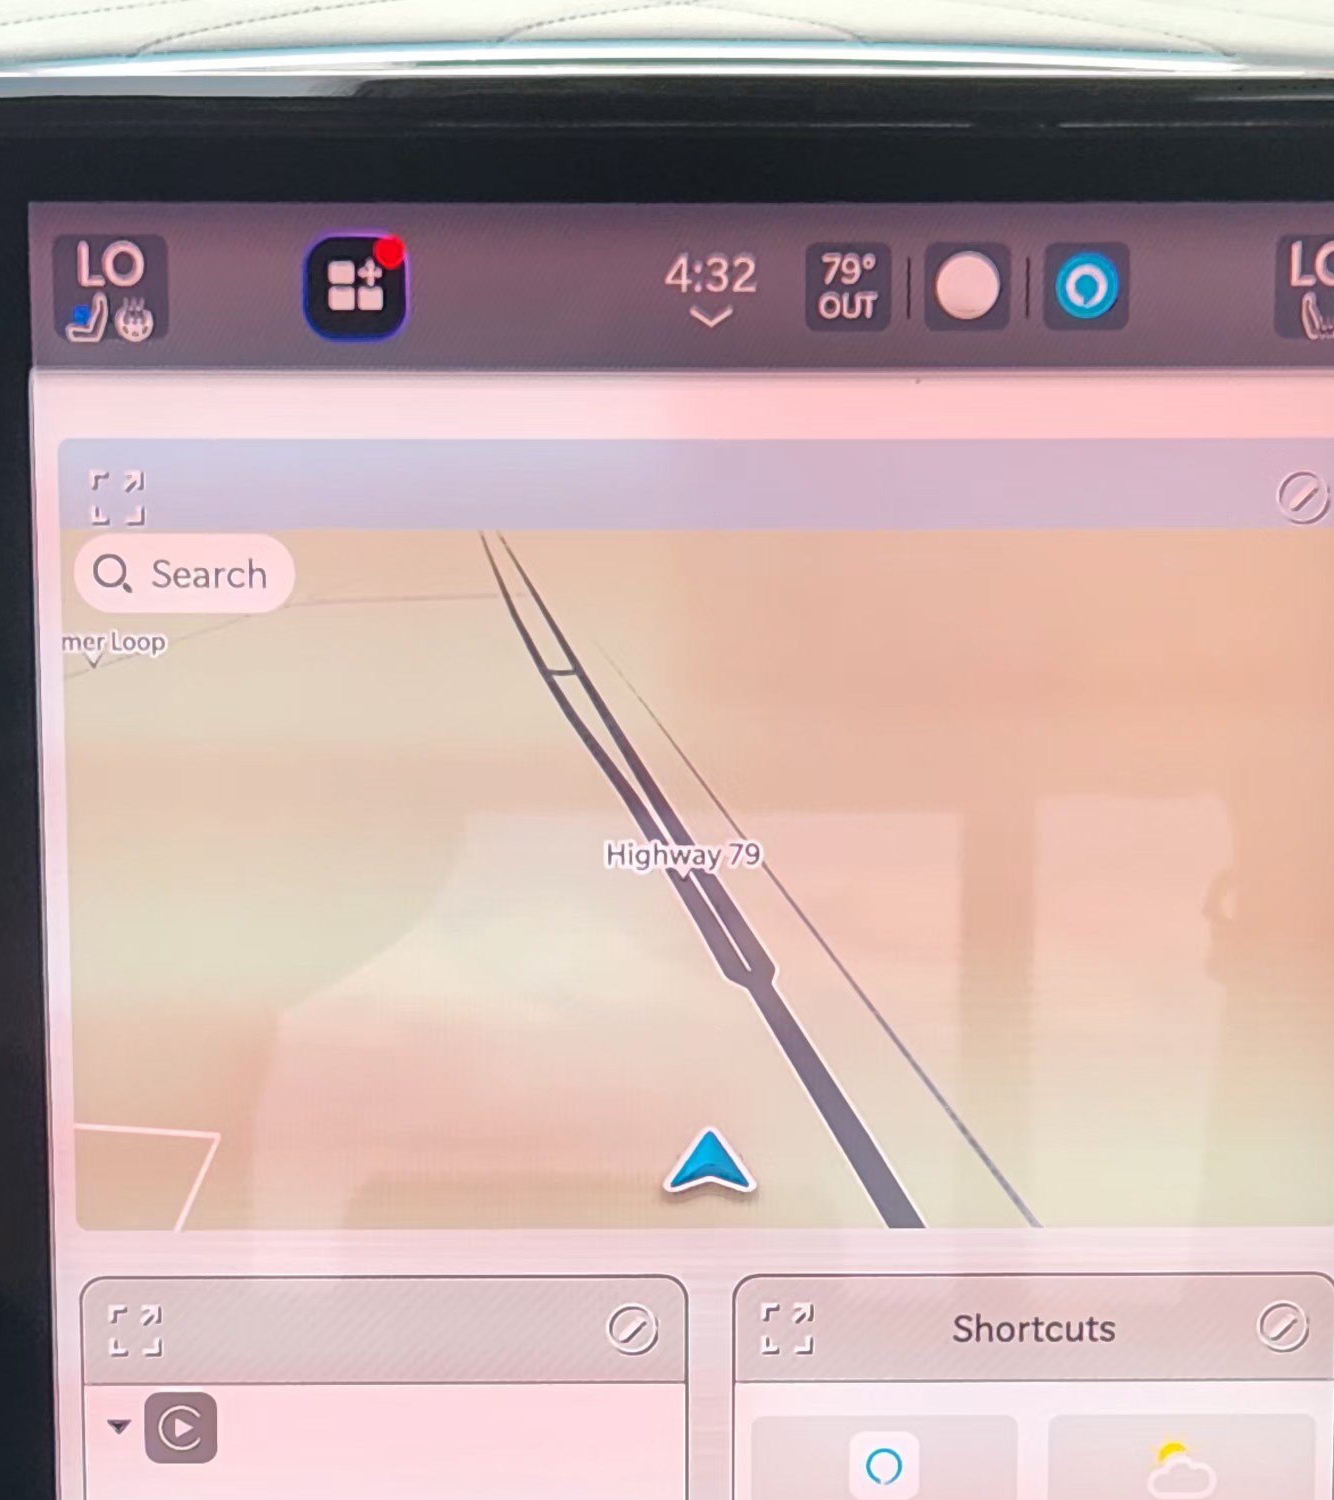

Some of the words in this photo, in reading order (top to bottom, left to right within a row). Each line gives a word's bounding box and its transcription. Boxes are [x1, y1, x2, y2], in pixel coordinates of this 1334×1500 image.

[77, 240, 144, 287] LO
[664, 254, 758, 295] 4:32
[822, 252, 876, 285] 79°
[818, 292, 878, 320] OUT
[151, 558, 267, 589] Search
[62, 636, 105, 651] mer
[112, 632, 166, 656] Loop
[607, 843, 722, 871] Highway
[728, 843, 761, 866] 79
[952, 1314, 1117, 1345] Shortcuts
